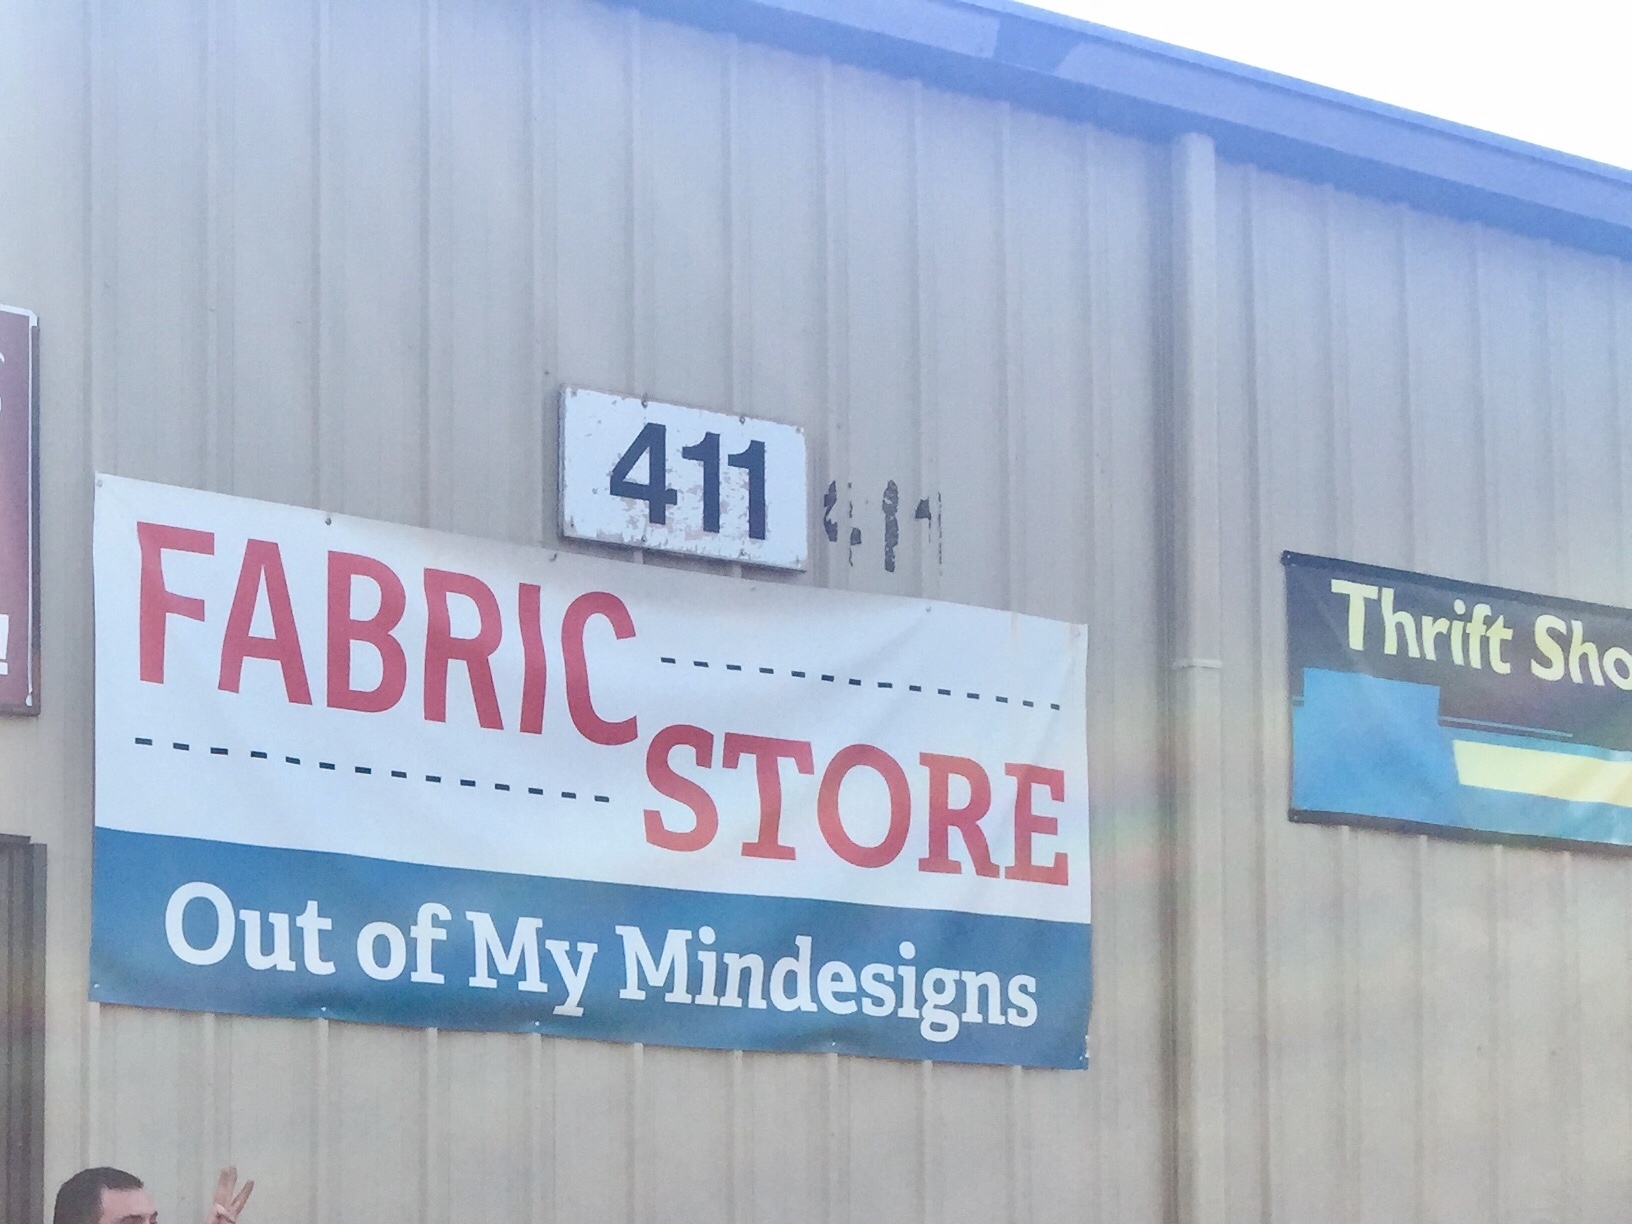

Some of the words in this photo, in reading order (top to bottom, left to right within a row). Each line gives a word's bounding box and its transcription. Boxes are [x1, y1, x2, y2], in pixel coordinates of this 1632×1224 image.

[609, 422, 767, 541] 411
[136, 521, 638, 746] FABRIC
[1331, 578, 1513, 676] Thrift
[1530, 614, 1632, 690] Sho
[643, 724, 1069, 886] STORE
[164, 881, 336, 975] Out
[356, 902, 452, 984] of
[467, 910, 598, 1017] My
[614, 924, 1039, 1042] Mindesigns
